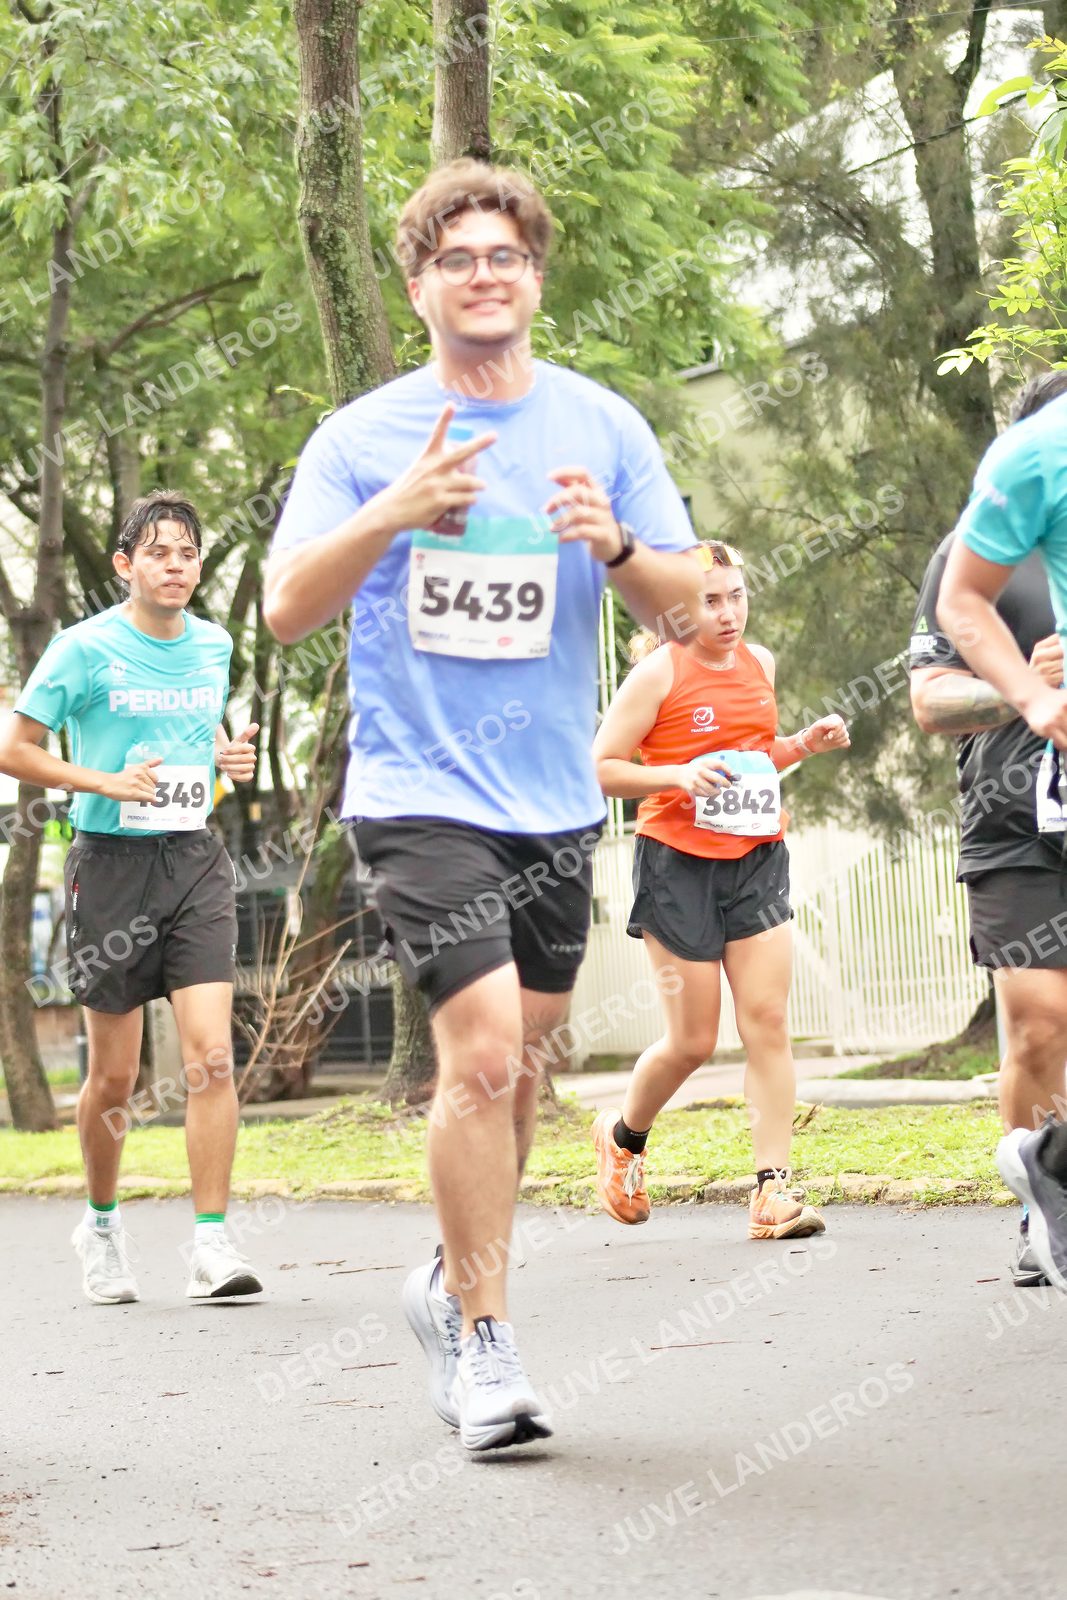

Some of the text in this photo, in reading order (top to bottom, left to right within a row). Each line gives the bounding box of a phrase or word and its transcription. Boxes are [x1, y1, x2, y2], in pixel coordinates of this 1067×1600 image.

[419, 575, 544, 622] 5439
[140, 782, 205, 808] 349
[703, 789, 776, 816] 3842
